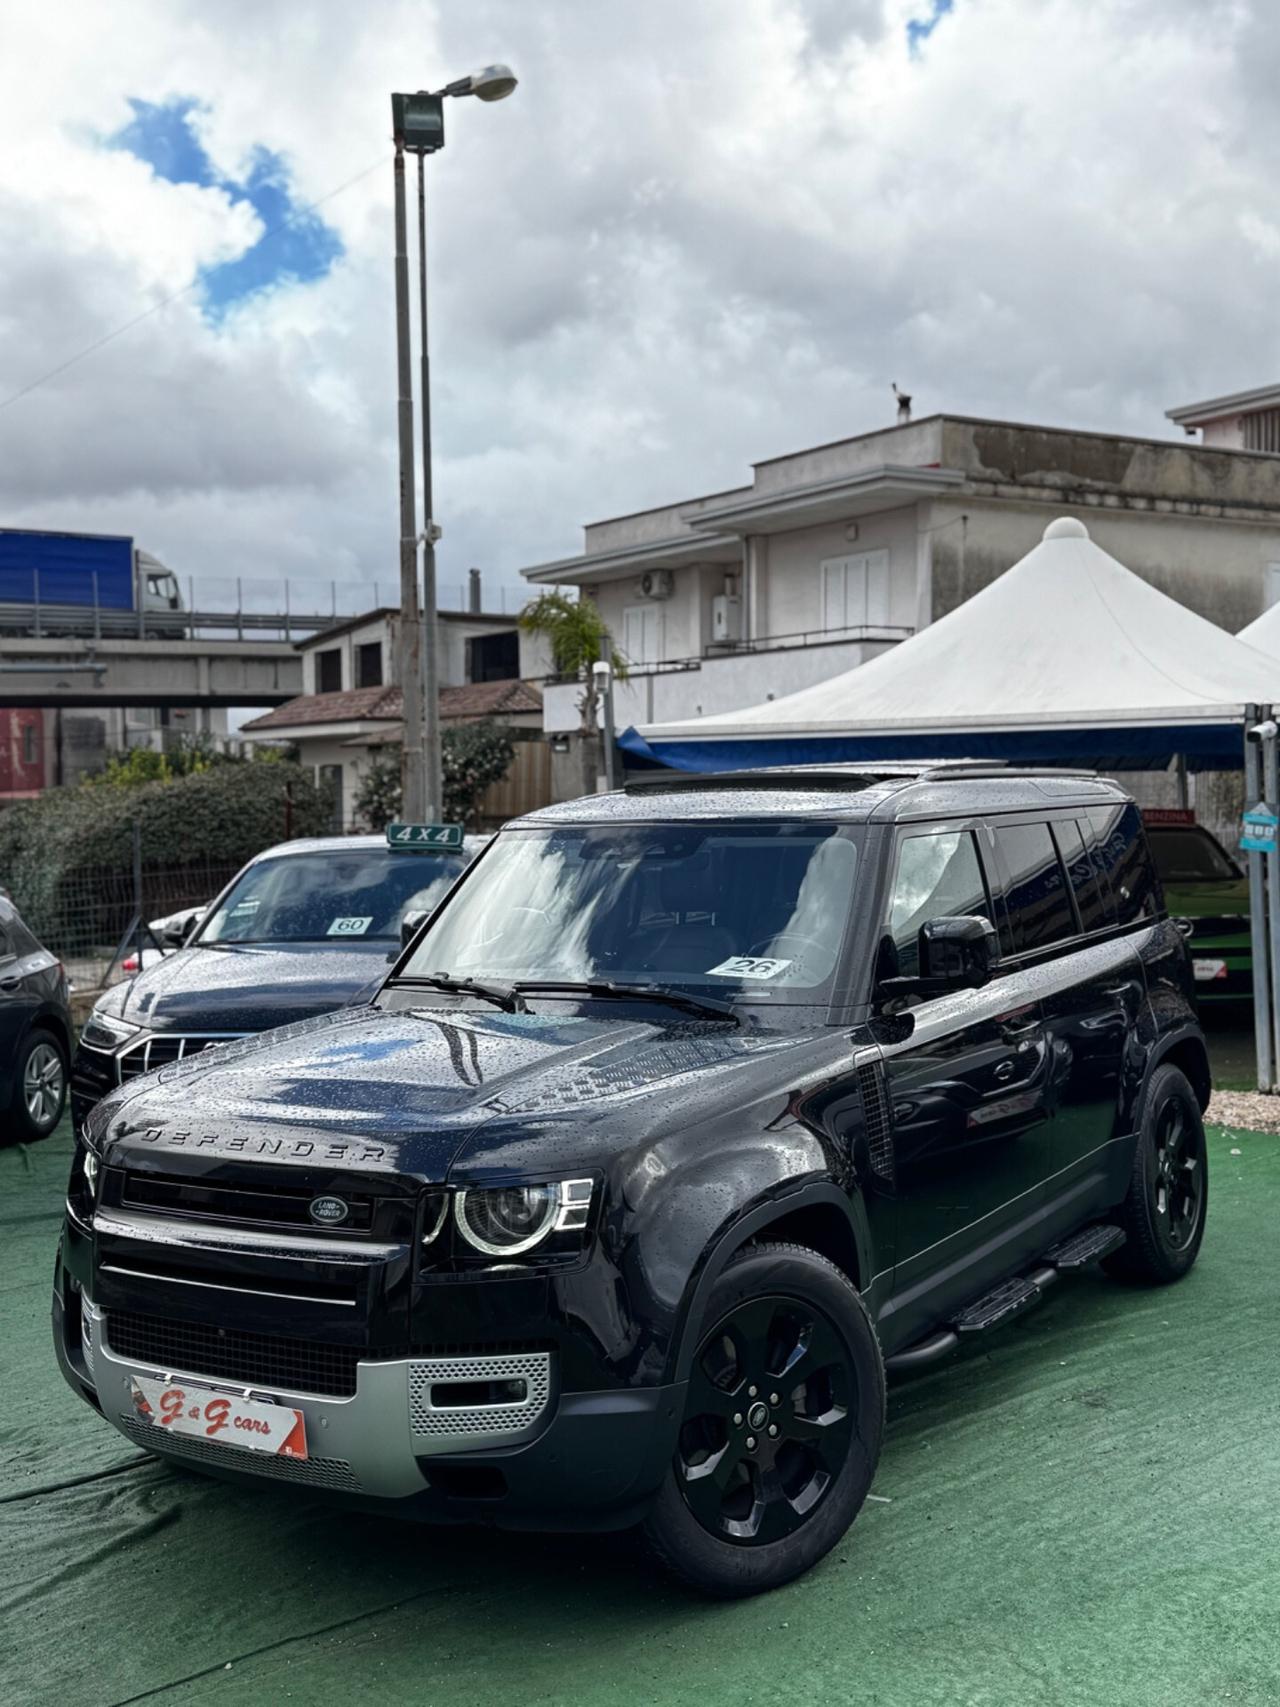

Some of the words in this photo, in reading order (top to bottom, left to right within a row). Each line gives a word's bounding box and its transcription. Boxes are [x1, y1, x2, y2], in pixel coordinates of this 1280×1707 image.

[337, 919, 364, 931] 60
[725, 959, 777, 973] 26
[141, 1128, 386, 1162] DEFENDER
[318, 1201, 337, 1210] LAND
[319, 1209, 341, 1217] ROVER
[159, 1389, 186, 1425] G
[204, 1398, 232, 1436] G
[233, 1415, 272, 1436] cars
